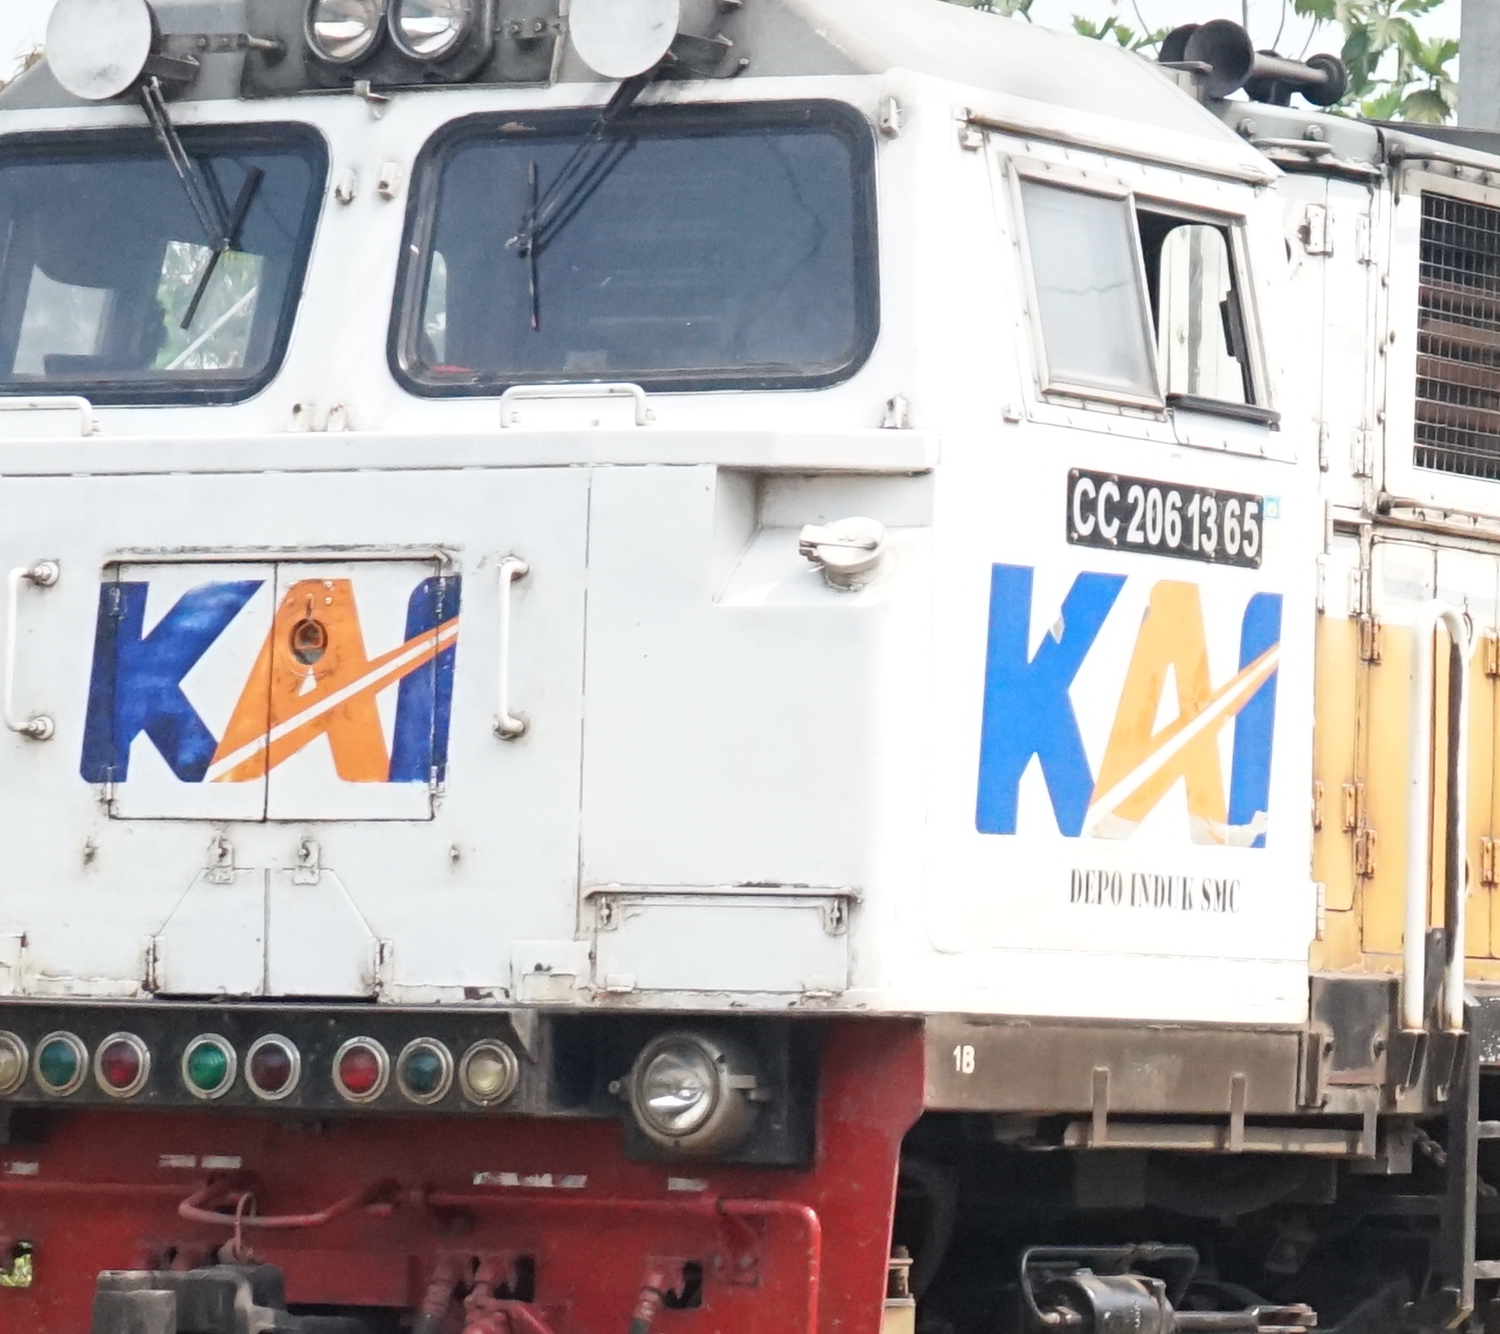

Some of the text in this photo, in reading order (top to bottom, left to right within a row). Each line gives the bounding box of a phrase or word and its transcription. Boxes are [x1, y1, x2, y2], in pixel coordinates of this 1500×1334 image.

[1073, 477, 1260, 558] CC 206 13 65
[80, 576, 462, 784] KAI
[975, 563, 1283, 849] KAI
[1070, 869, 1241, 913] DEPO INDUK SMC
[953, 1045, 975, 1074] 1B
